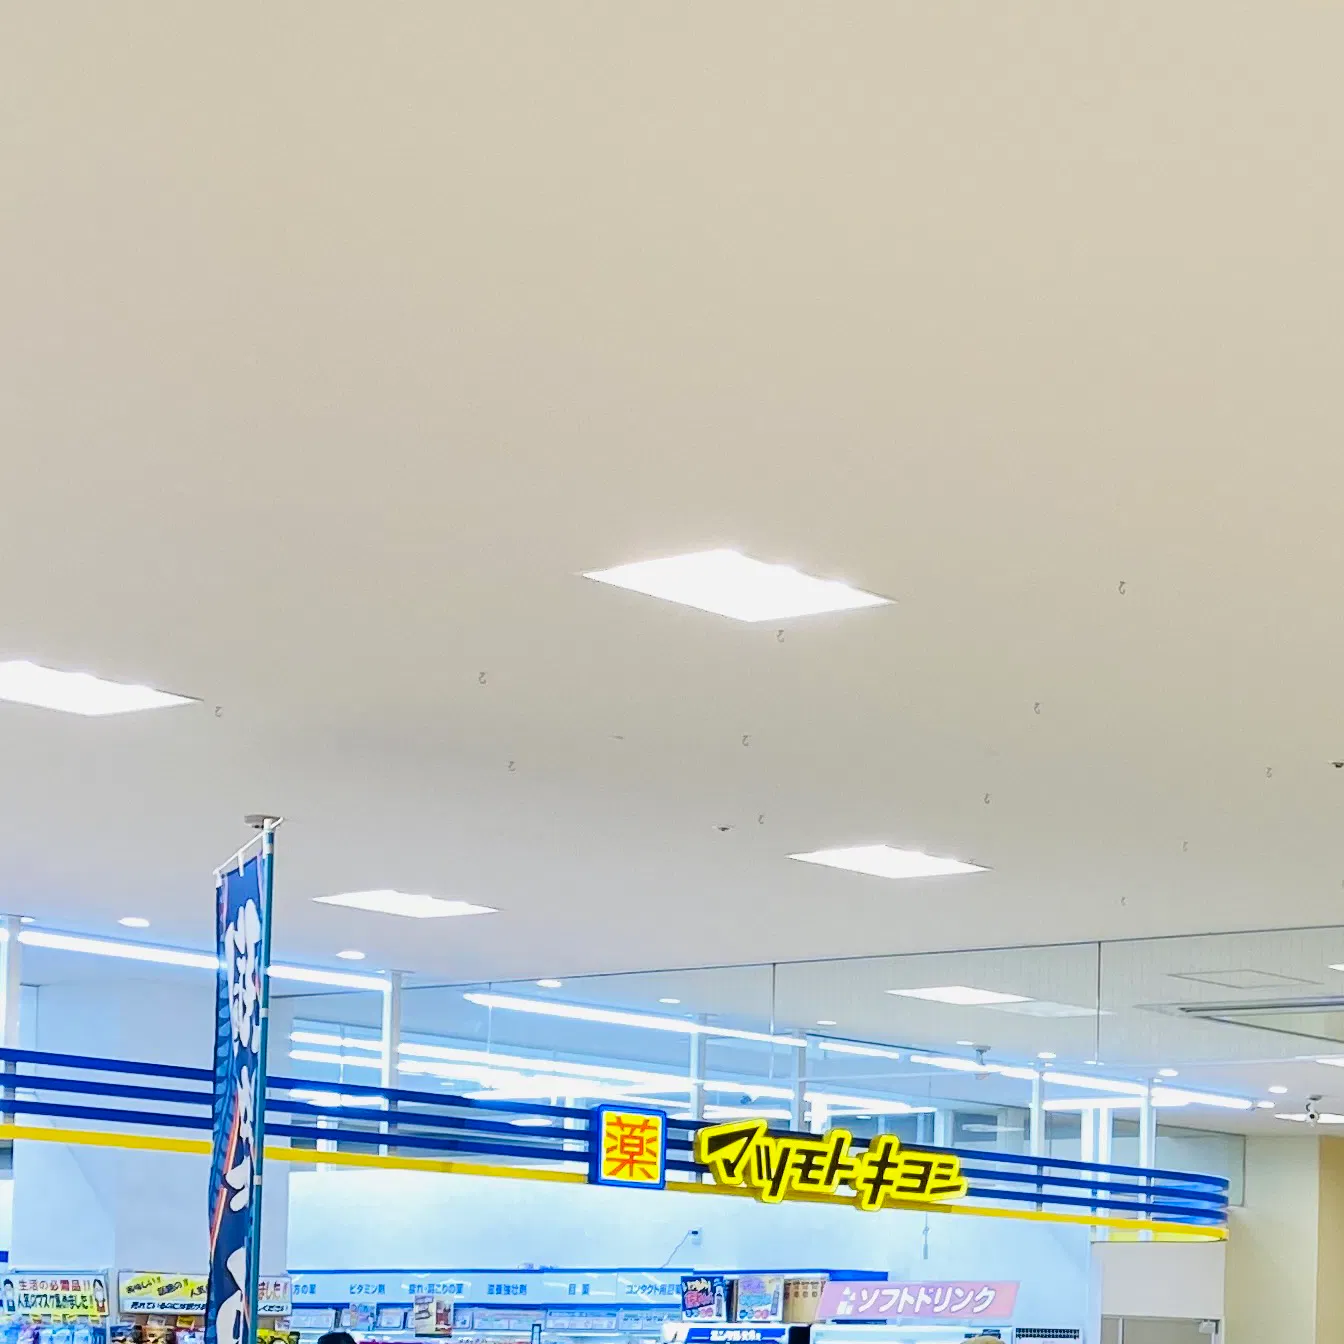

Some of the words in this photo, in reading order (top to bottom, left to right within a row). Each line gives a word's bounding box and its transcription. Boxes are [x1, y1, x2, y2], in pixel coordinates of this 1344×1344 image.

[605, 1116, 657, 1181] 薬
[705, 1124, 965, 1206] マツモトキヨシ
[857, 1285, 997, 1314] ソフトドリンク
